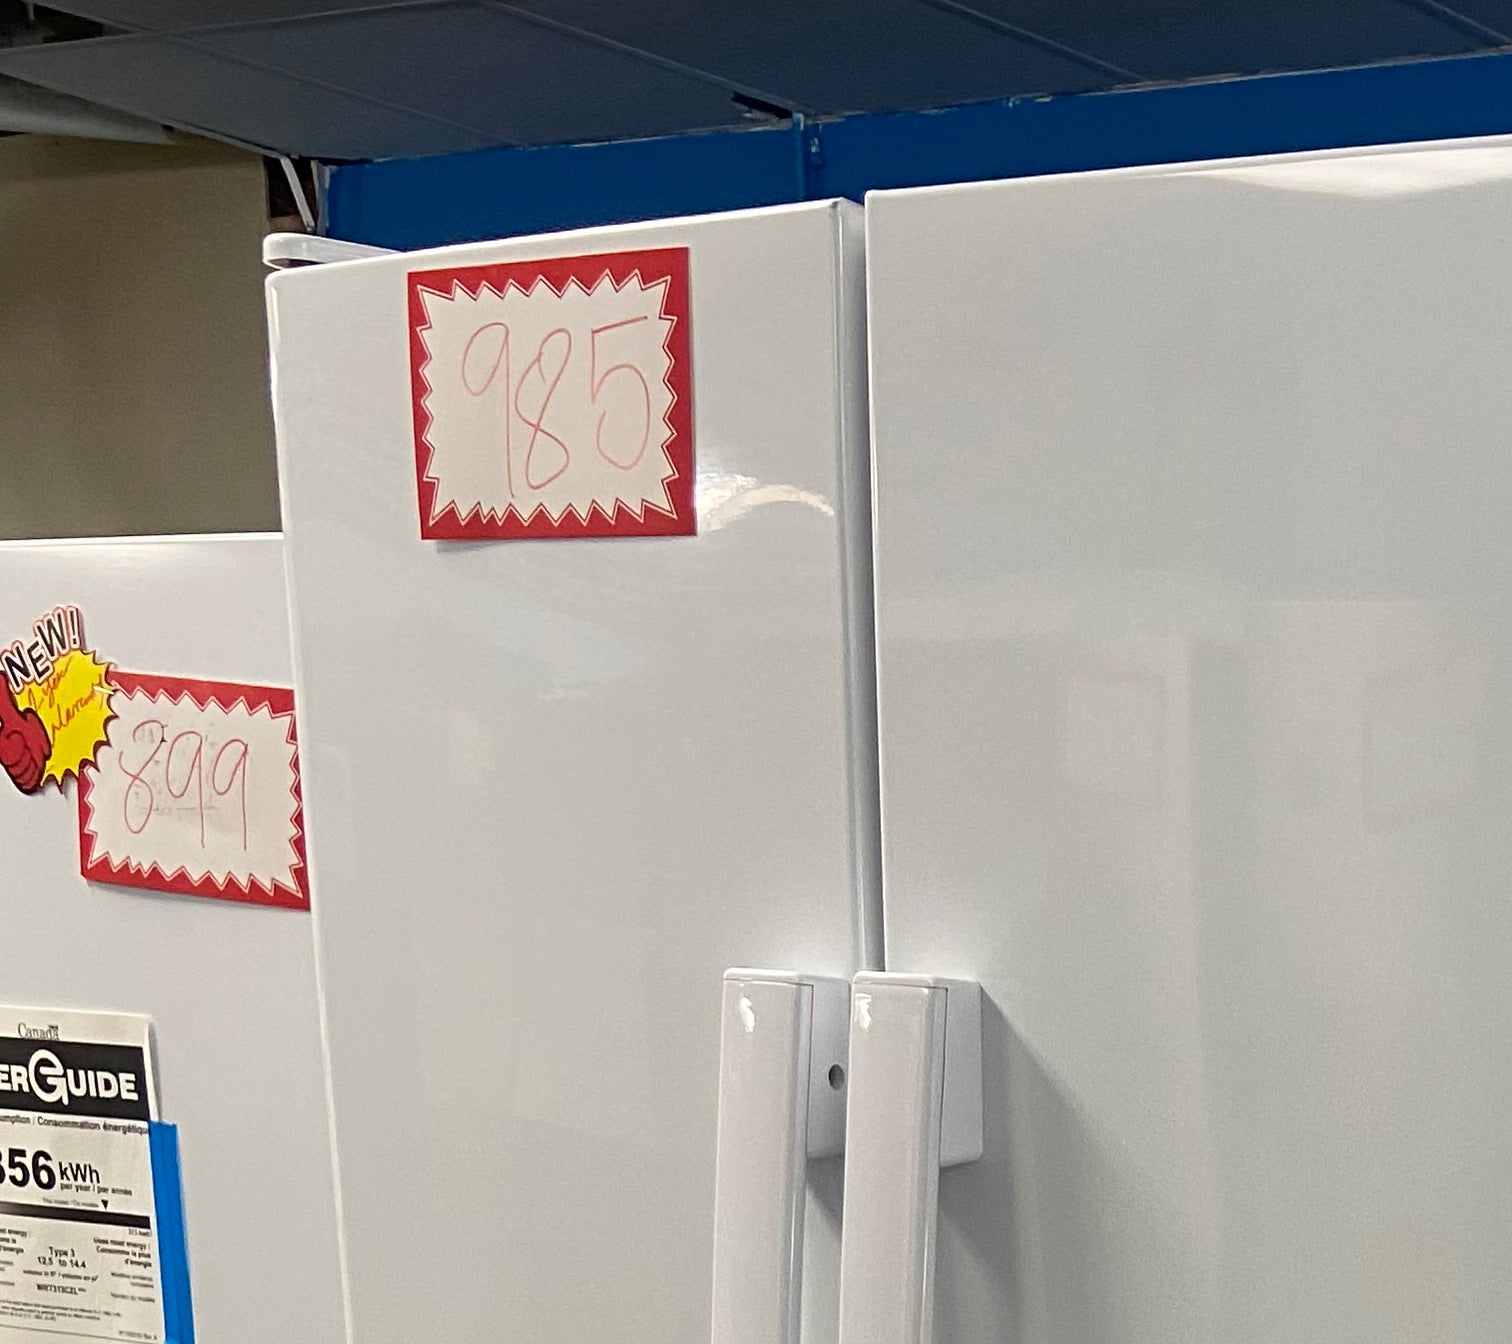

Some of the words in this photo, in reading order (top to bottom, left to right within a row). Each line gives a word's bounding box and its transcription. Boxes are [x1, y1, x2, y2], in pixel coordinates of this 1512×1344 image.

[461, 315, 651, 498] 985
[3, 606, 78, 690] NEW!
[118, 719, 249, 851] 899
[0, 1148, 56, 1190] 56
[58, 1161, 101, 1184] kWh
